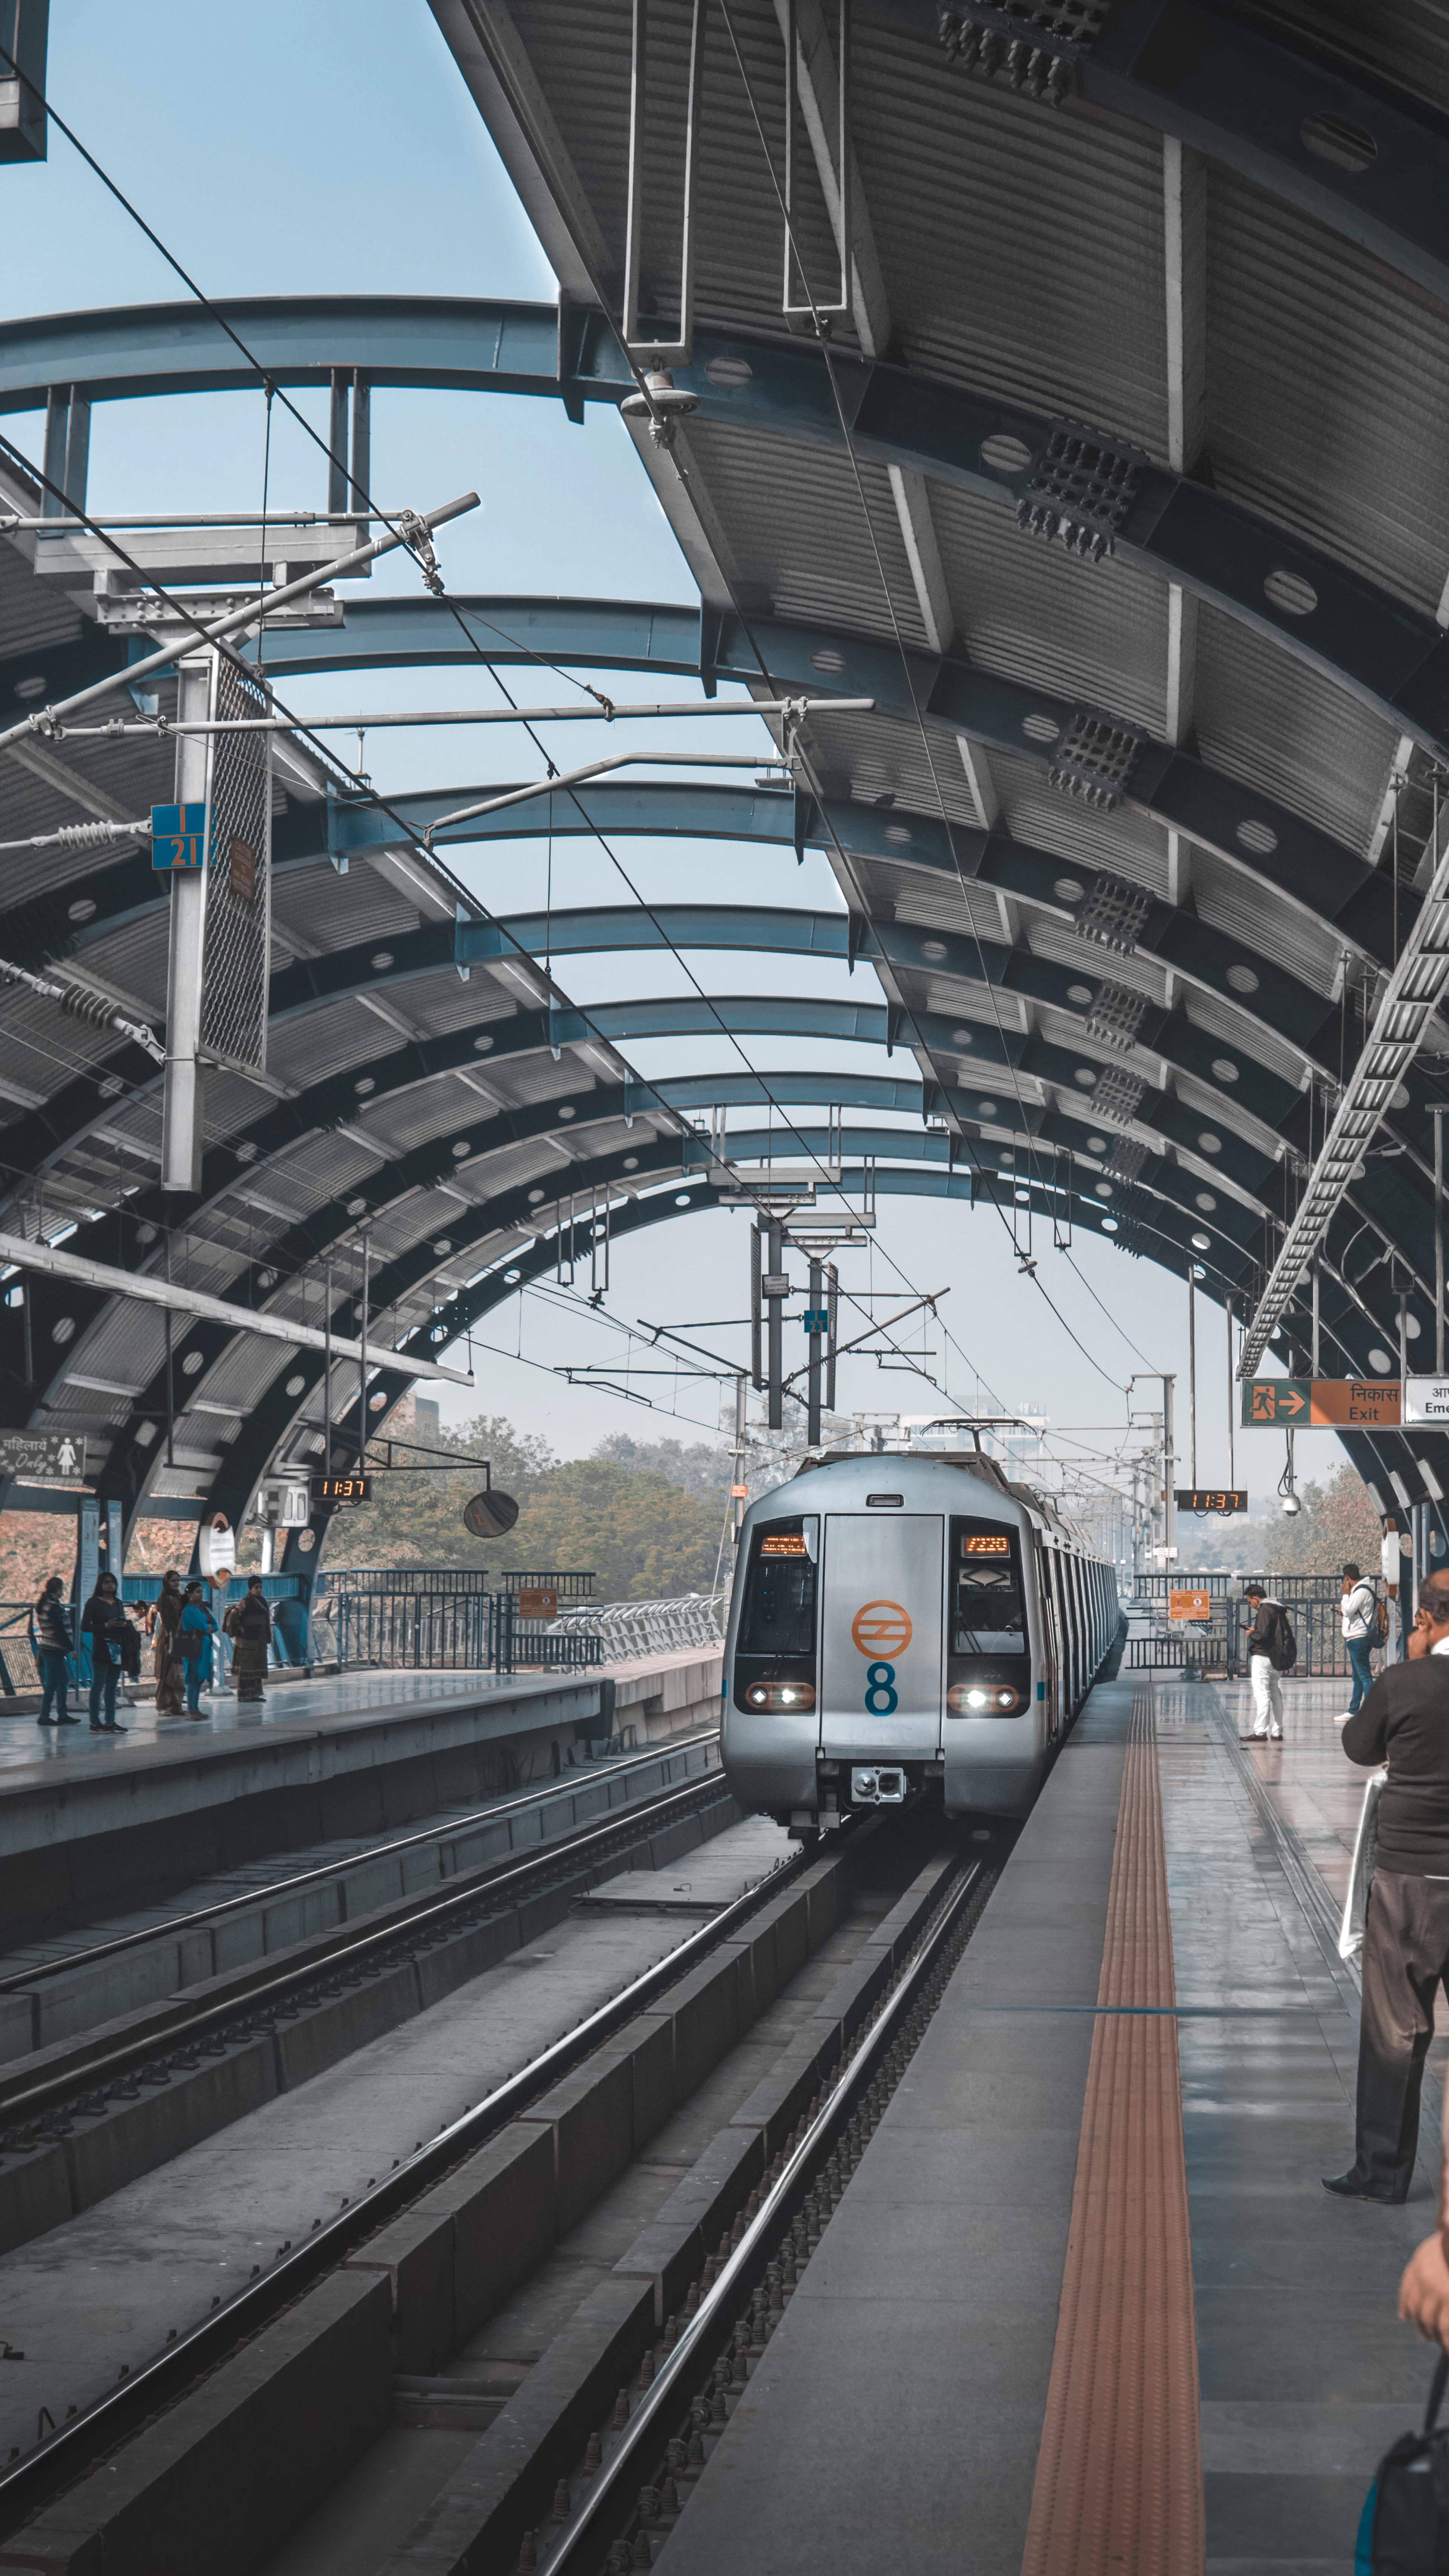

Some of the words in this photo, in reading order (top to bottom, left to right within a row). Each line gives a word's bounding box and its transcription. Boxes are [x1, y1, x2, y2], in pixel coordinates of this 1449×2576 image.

[171, 838, 196, 865] 21
[810, 1322, 823, 1332] 23
[1350, 1383, 1400, 1402] निकास
[1349, 1407, 1379, 1420] Exit
[15, 1453, 47, 1474] Only
[323, 1481, 364, 1496] 11:37
[1193, 1494, 1238, 1508] 11:37
[865, 1662, 898, 1717] 8
